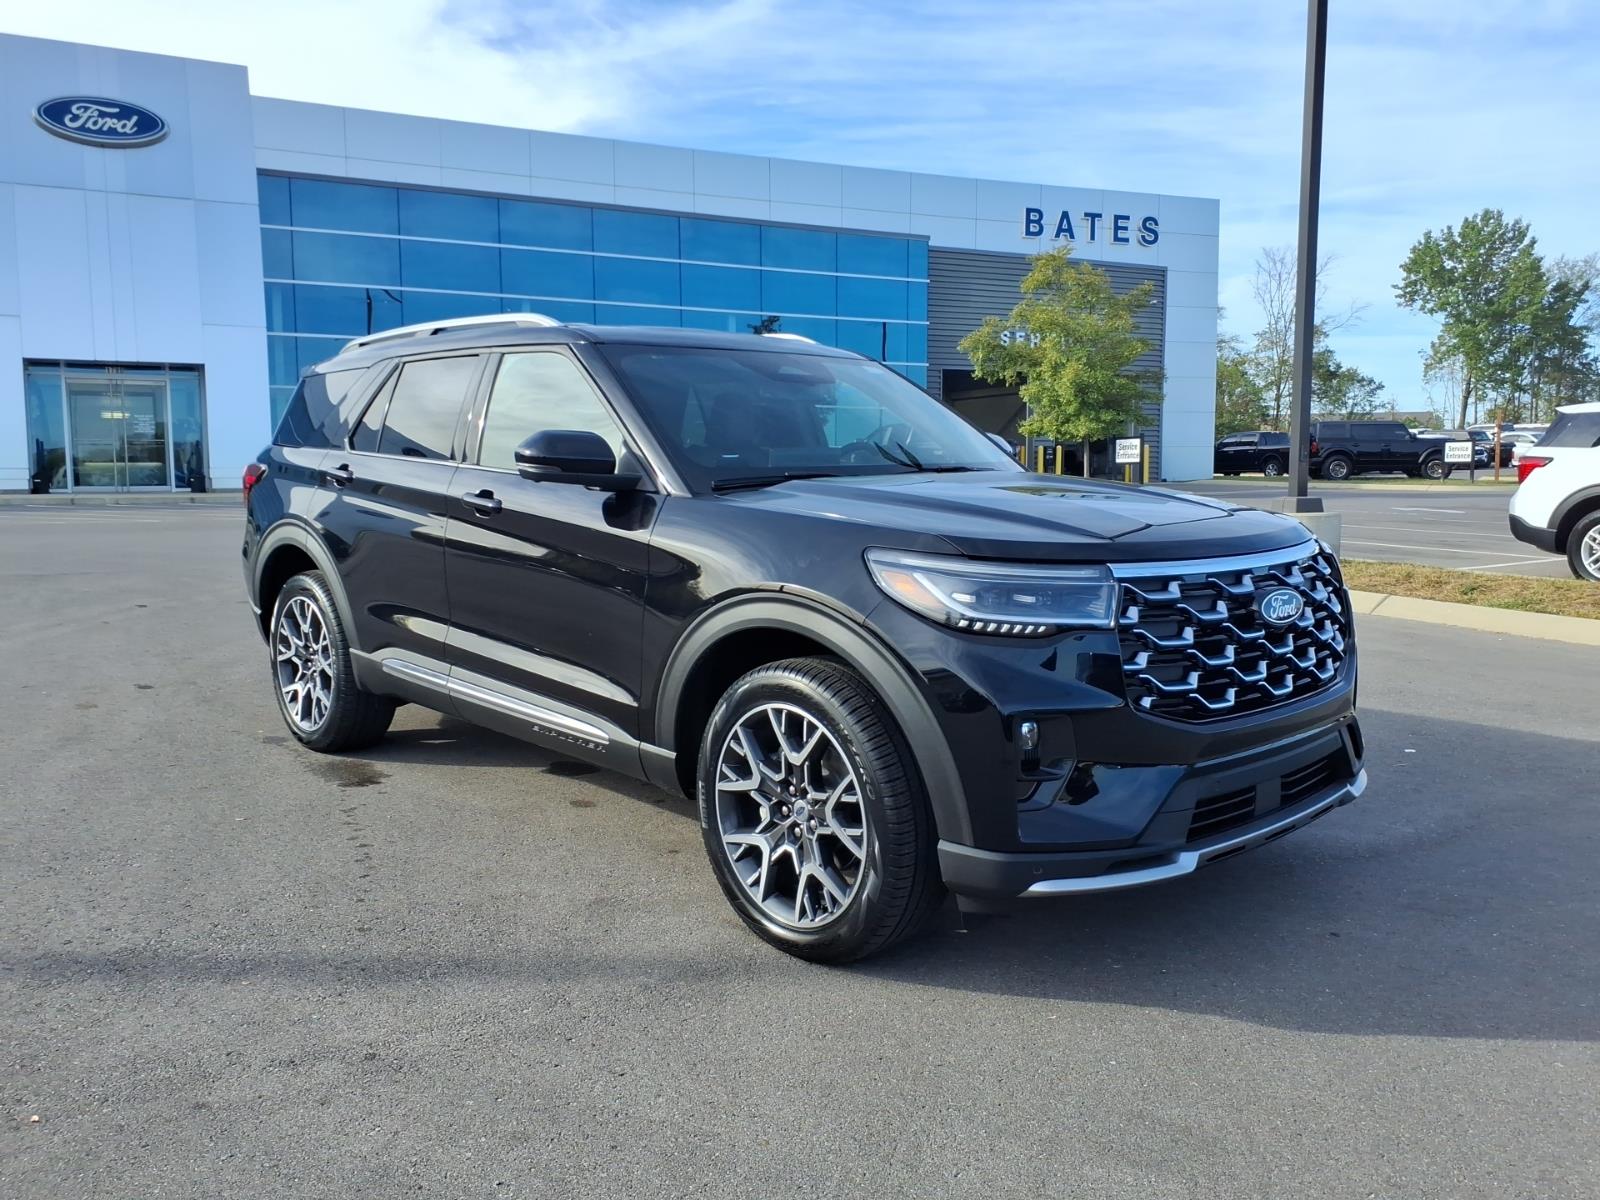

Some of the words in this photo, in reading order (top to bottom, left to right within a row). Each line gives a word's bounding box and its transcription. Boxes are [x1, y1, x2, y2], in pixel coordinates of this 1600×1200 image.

[64, 102, 139, 134] Ford
[1024, 207, 1160, 246] BATES
[1118, 443, 1138, 451] Service
[1270, 595, 1297, 619] Ford
